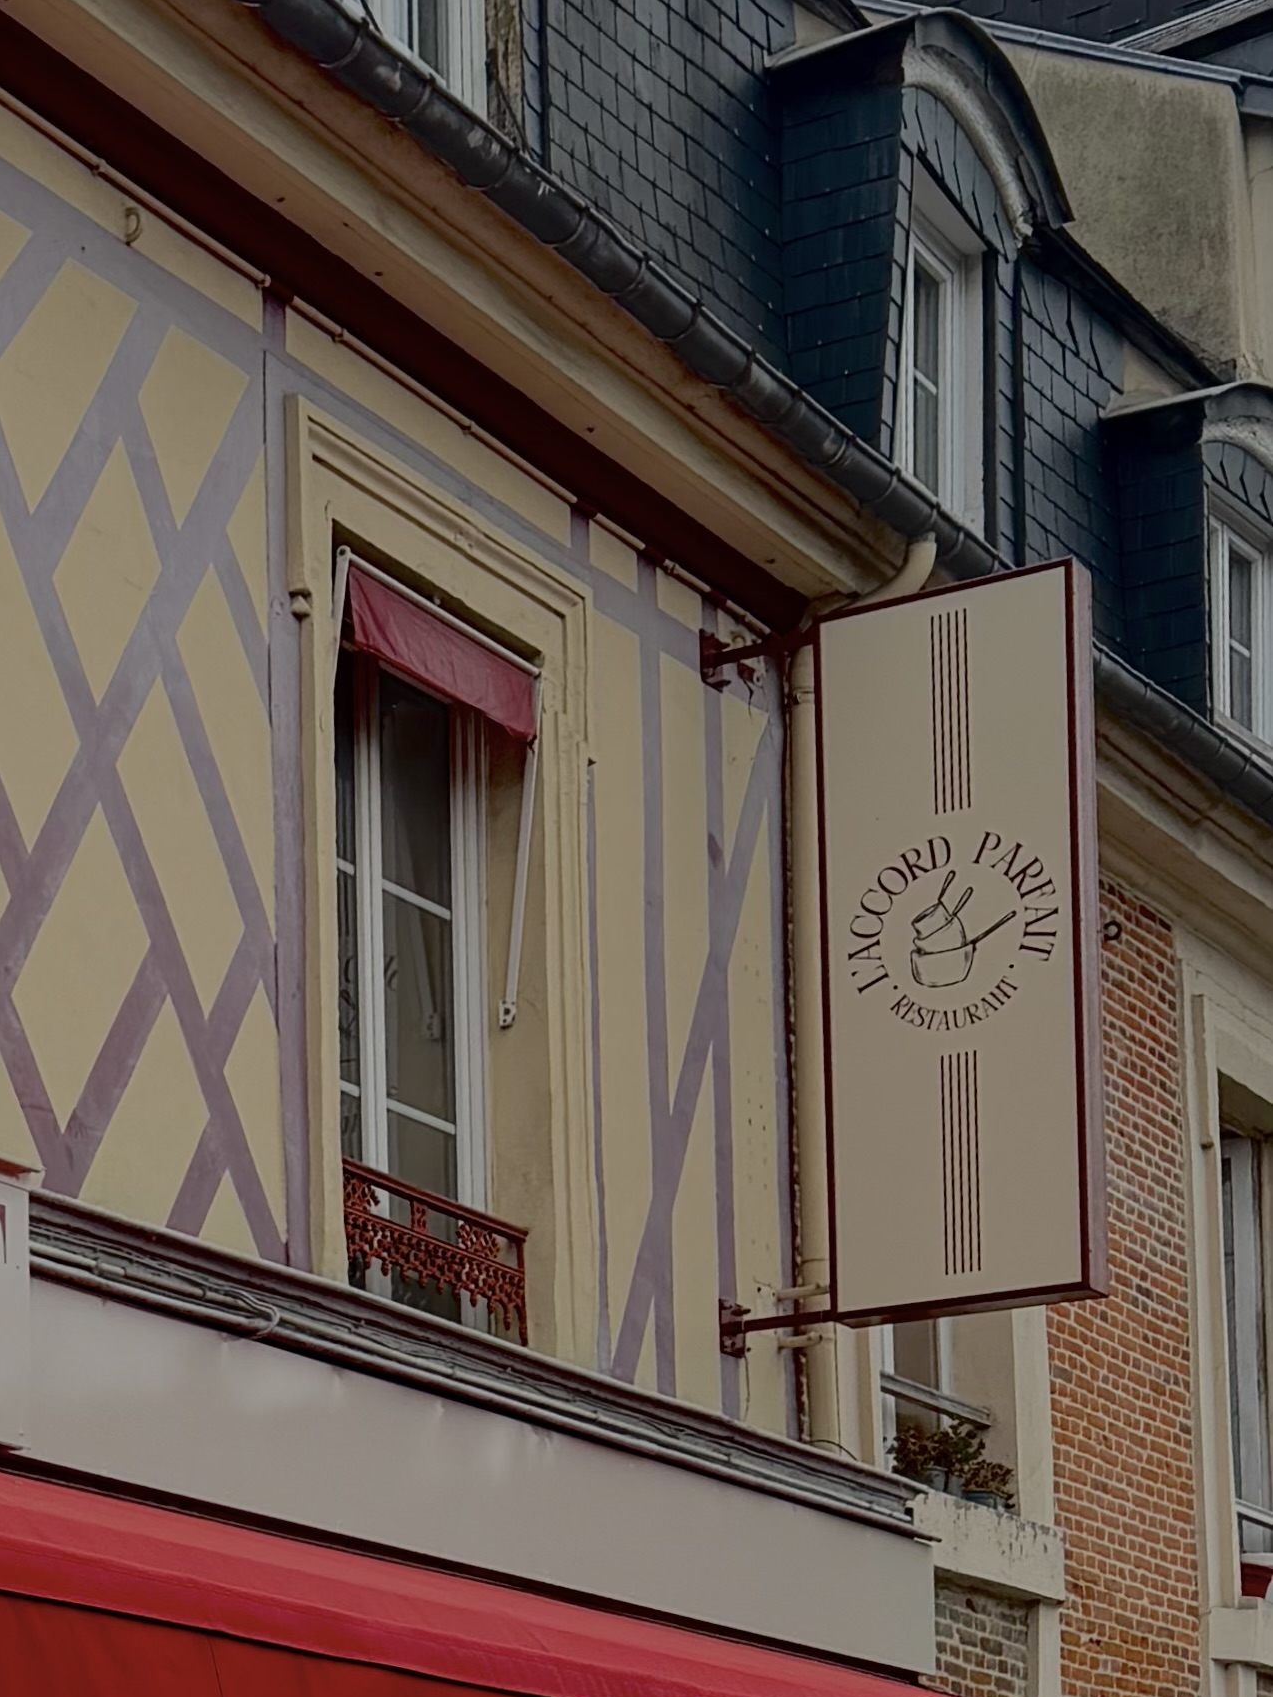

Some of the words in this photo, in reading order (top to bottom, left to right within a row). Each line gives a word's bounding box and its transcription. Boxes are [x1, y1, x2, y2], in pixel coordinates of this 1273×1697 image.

[847, 835, 952, 995] L'ACCORD
[971, 831, 1060, 962] PARFAIT
[890, 974, 1019, 1032] RESTAURANT
